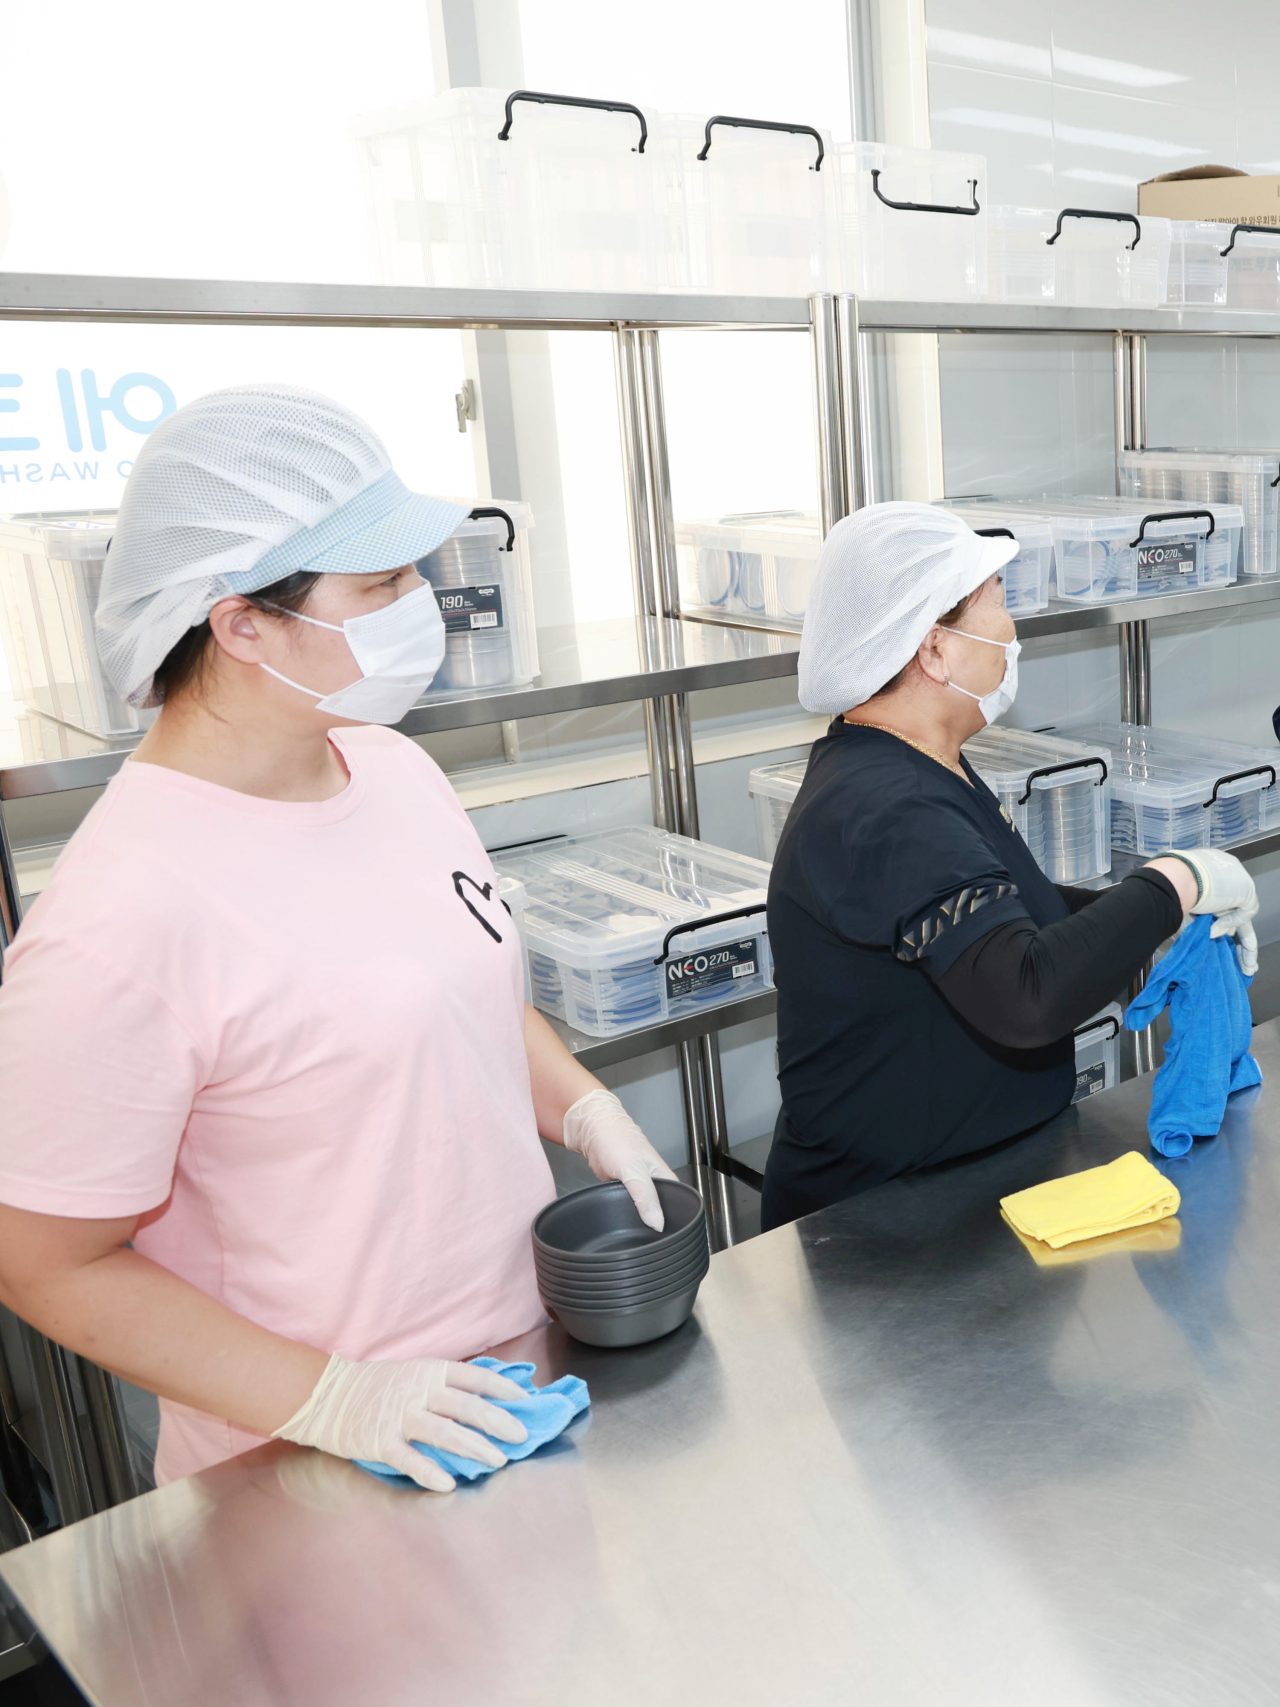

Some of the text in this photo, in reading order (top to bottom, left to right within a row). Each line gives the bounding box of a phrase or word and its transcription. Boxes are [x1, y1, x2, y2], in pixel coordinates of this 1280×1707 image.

[1248, 215, 1277, 226] 와우회원
[1138, 548, 1164, 565] NEO
[1164, 548, 1178, 559] 270
[440, 595, 464, 610] 190
[668, 956, 708, 981] NEO
[709, 951, 729, 967] 270
